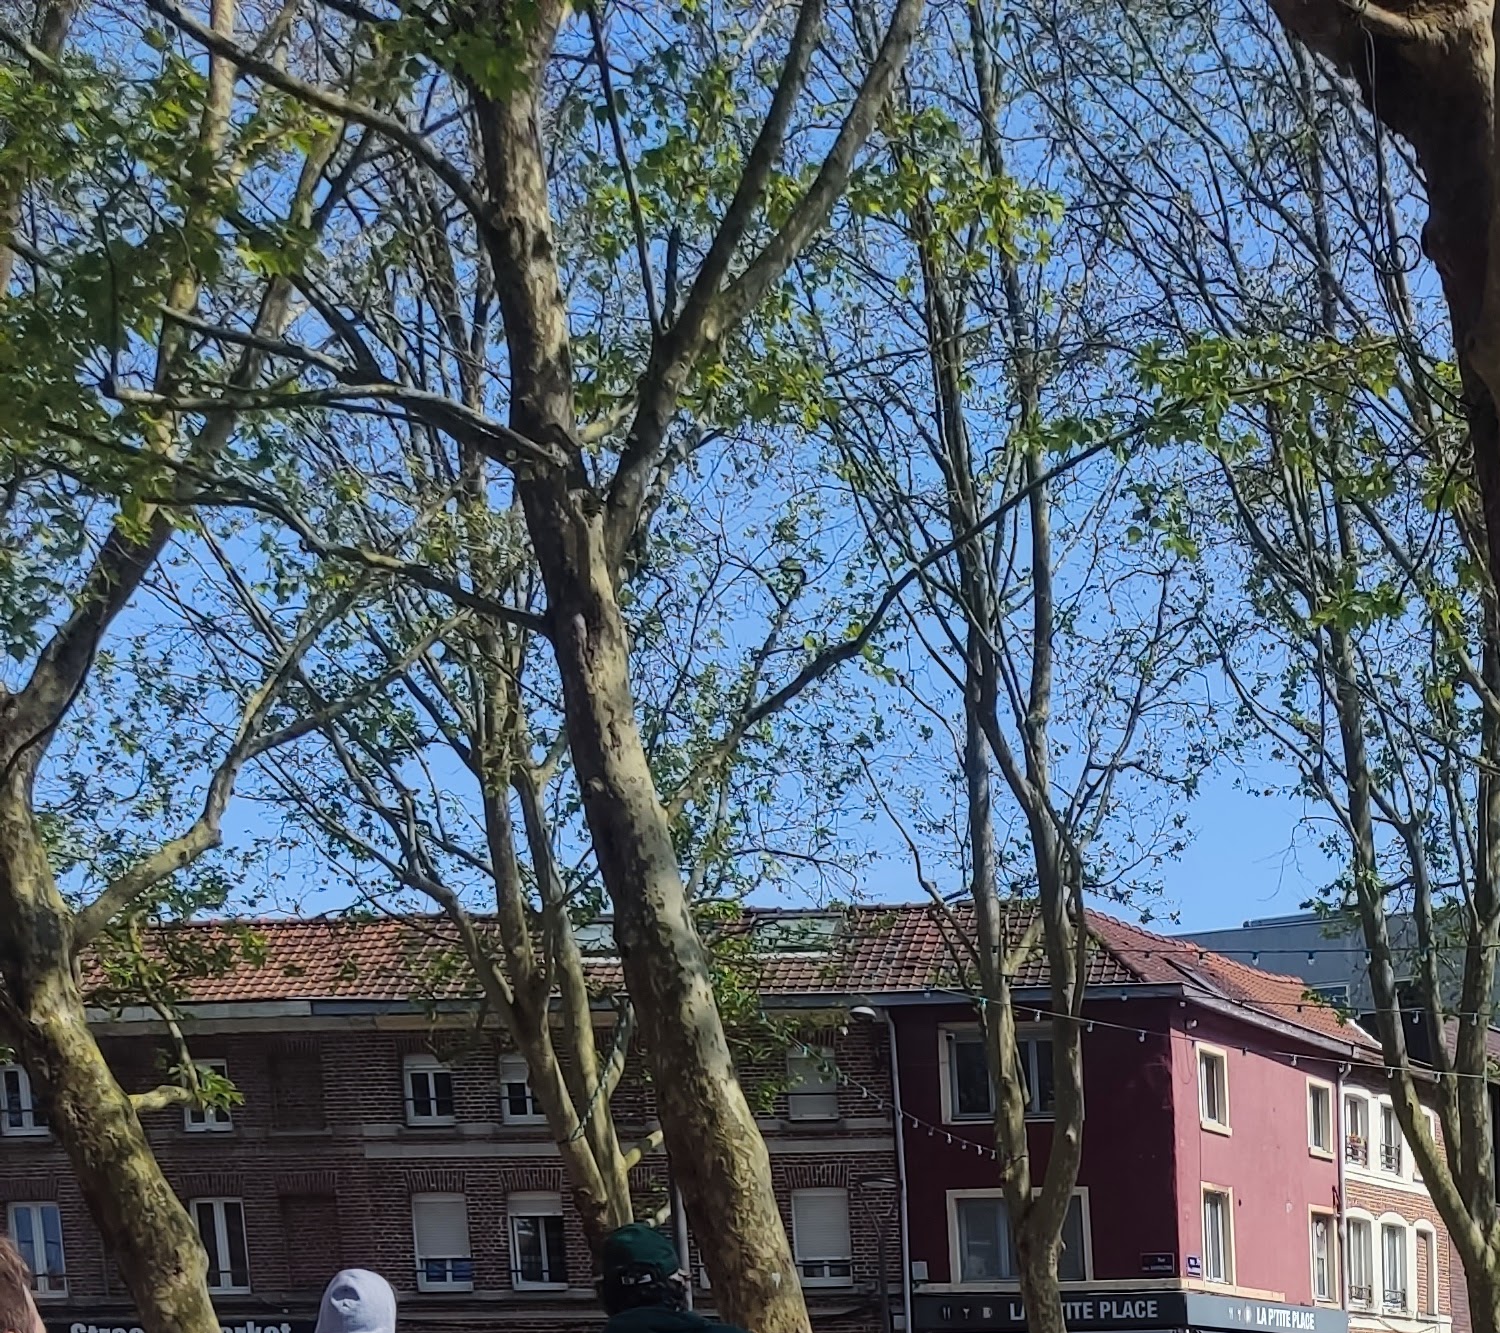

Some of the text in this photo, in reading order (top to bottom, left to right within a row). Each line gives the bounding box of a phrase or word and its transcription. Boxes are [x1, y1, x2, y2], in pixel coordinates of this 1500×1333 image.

[1100, 1301, 1158, 1319] PLACE
[1256, 1306, 1267, 1326] LA
[1291, 1310, 1315, 1330] PLACE
